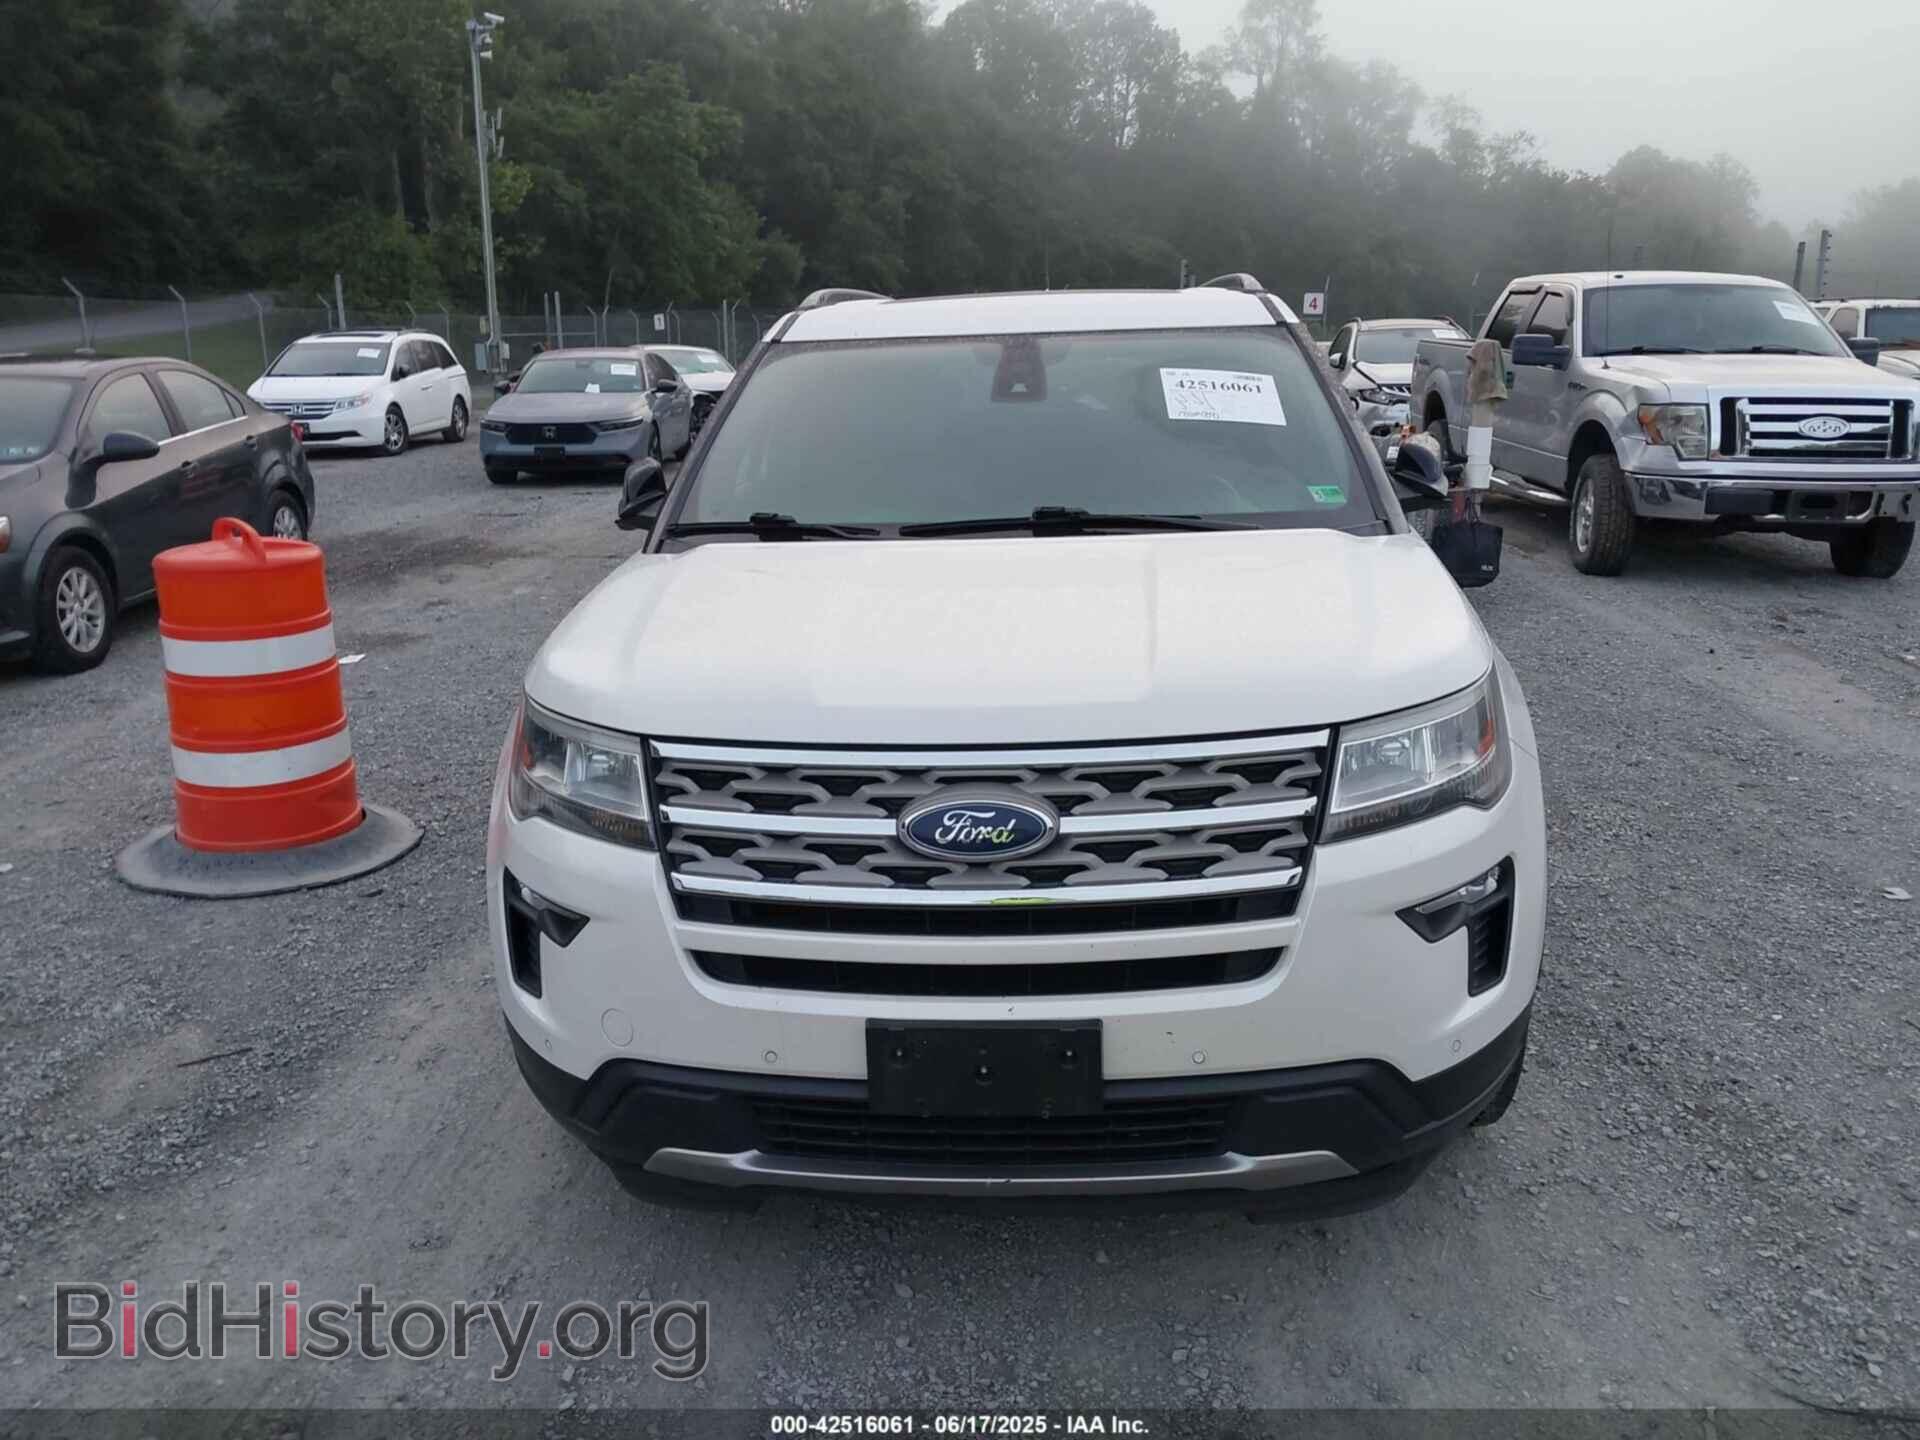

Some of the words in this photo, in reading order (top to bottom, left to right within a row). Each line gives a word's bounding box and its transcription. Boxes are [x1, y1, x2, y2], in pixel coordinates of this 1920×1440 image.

[1308, 296, 1318, 310] 4
[1175, 379, 1263, 394] 42516061
[935, 809, 1017, 845] Ford
